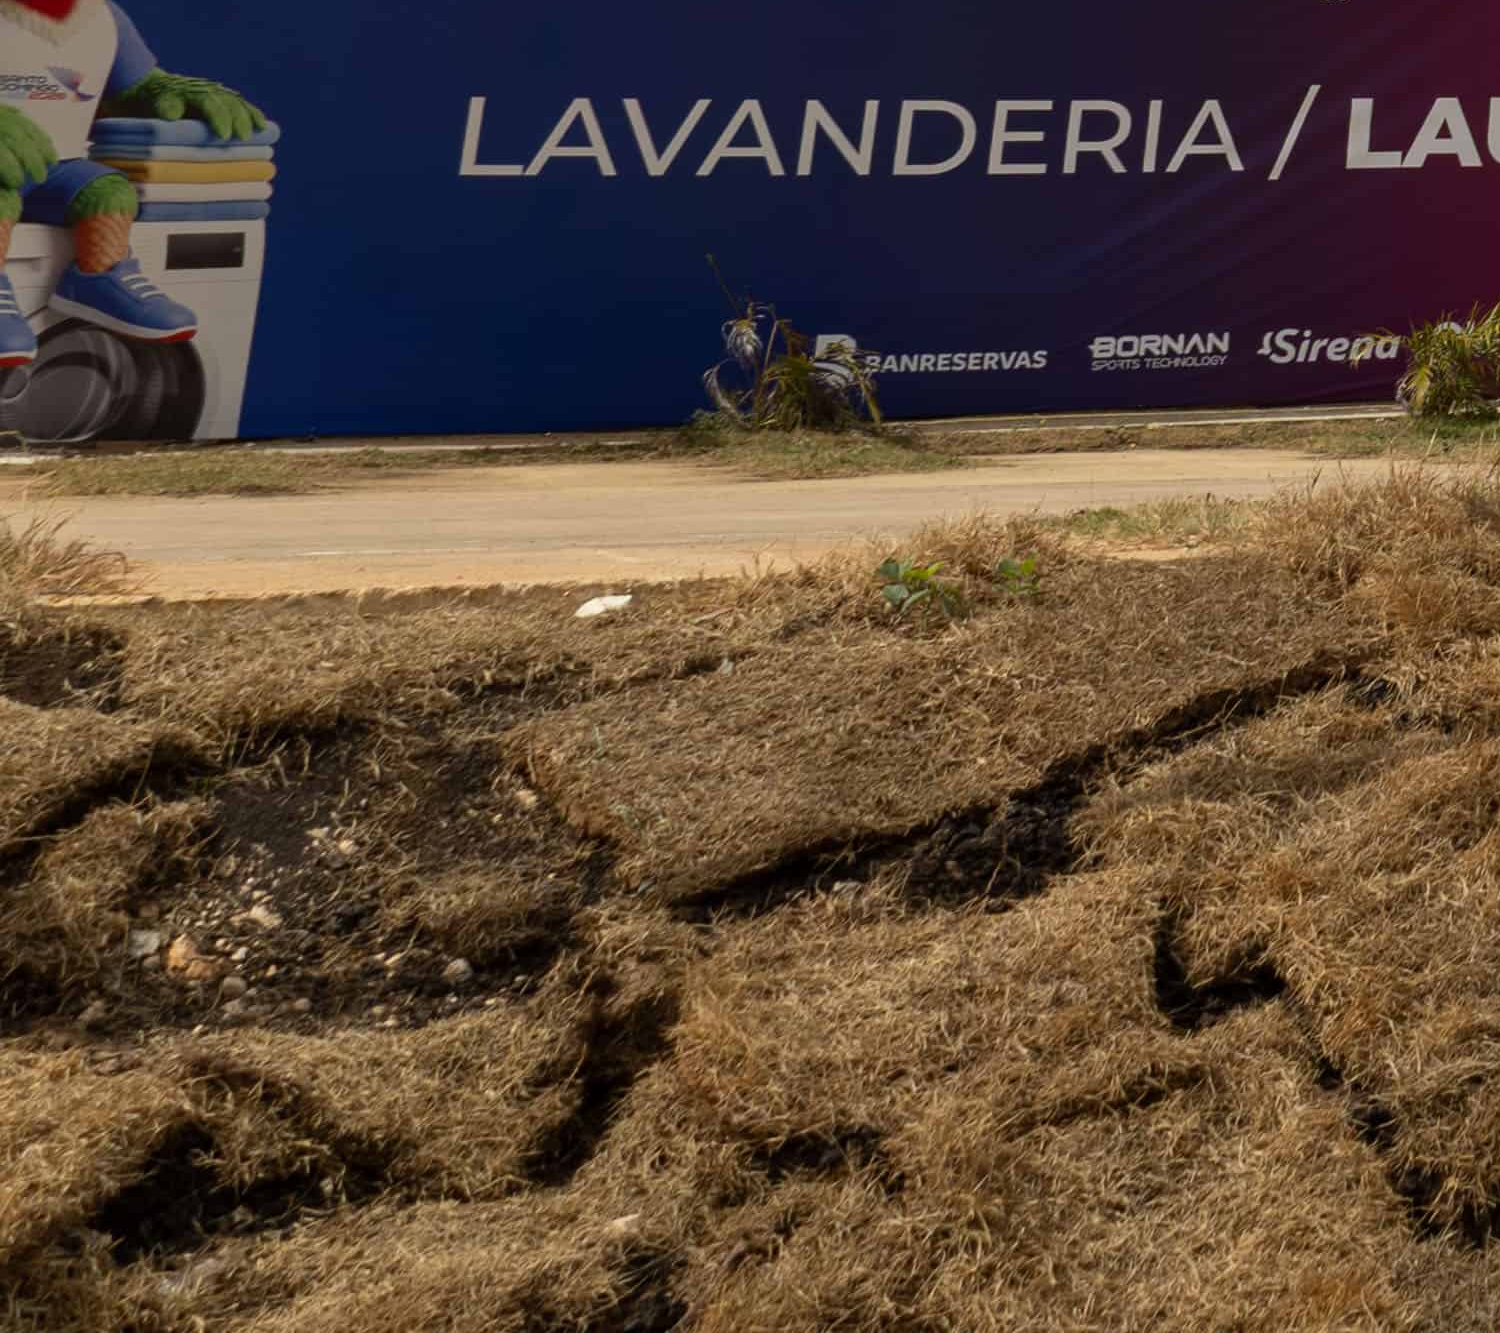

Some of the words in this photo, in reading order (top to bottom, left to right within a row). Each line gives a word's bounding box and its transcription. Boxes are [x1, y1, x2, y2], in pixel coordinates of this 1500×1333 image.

[458, 95, 1244, 178] LAVANDERIA
[1090, 331, 1230, 358] BORNAN
[1269, 328, 1401, 364] Sirena
[866, 349, 1048, 374] BANRESERVAS
[1091, 358, 1141, 371] SPORTS
[1144, 354, 1228, 370] TECHNOLOGY
